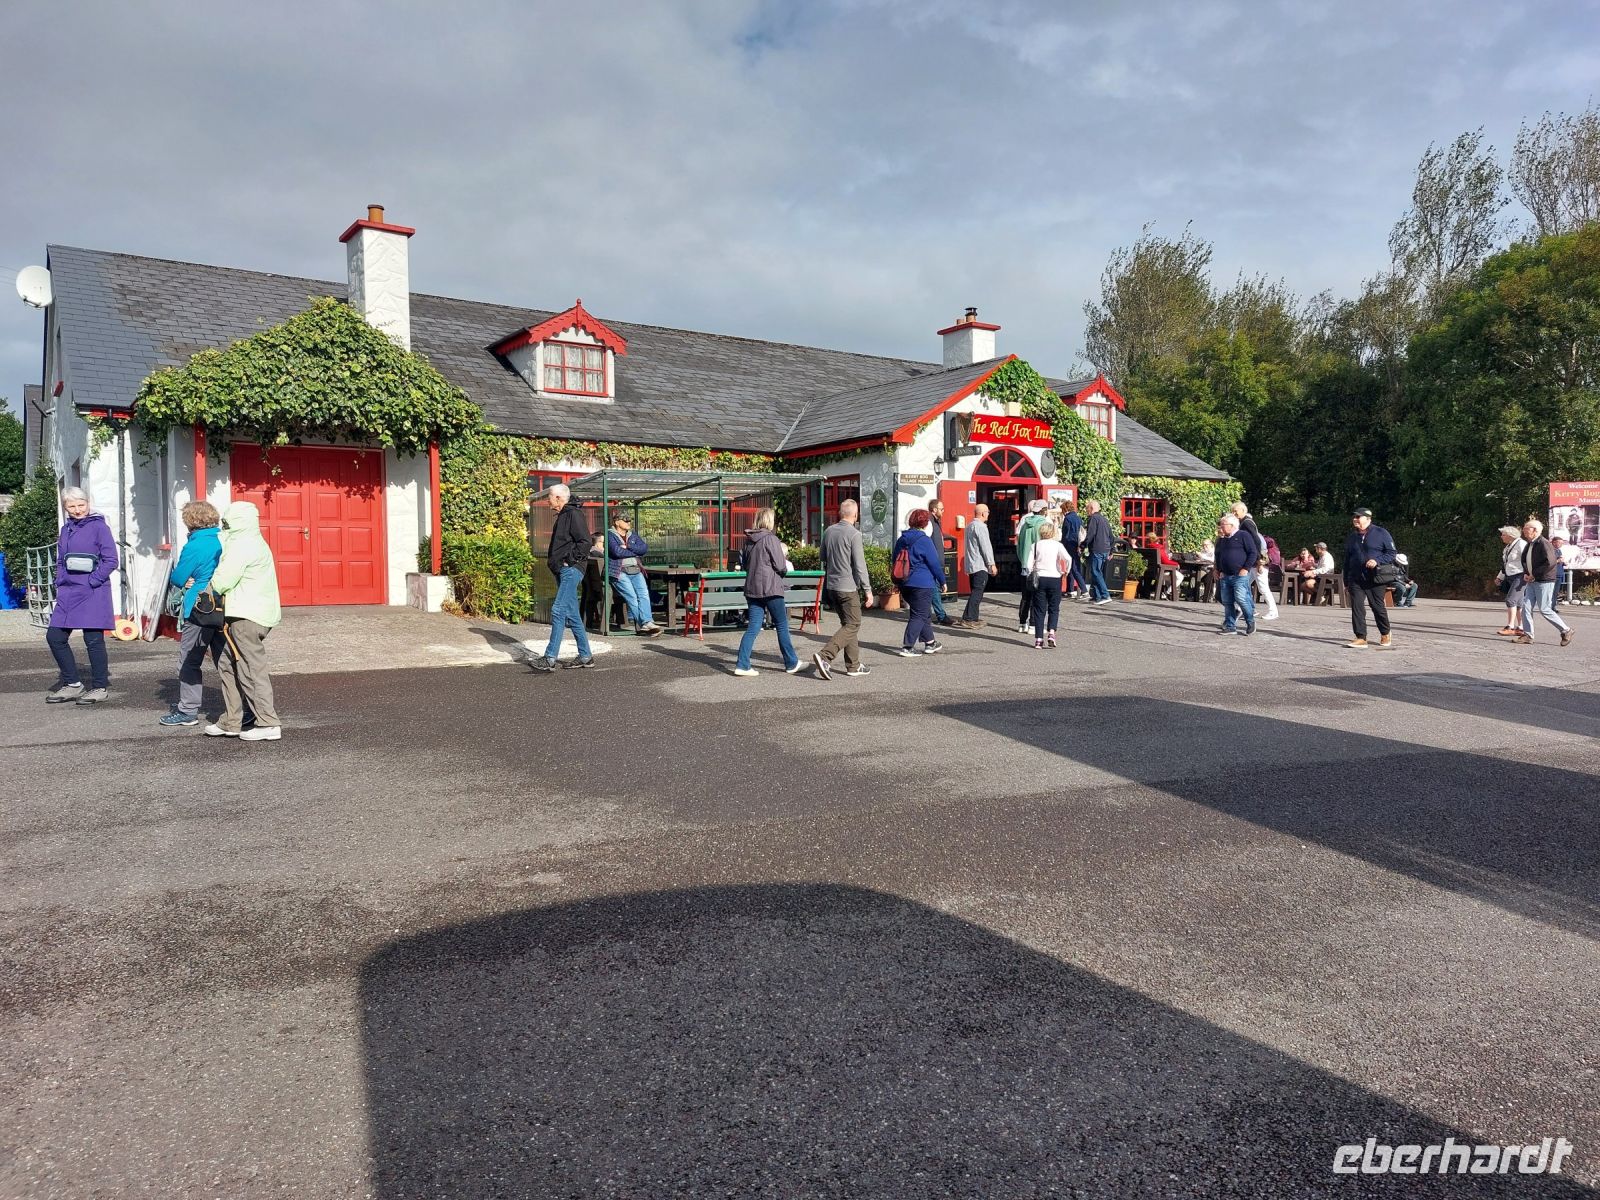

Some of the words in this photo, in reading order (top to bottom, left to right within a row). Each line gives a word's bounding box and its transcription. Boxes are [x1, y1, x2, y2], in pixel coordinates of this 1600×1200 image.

[973, 418, 987, 433] he
[989, 421, 1012, 438] Red
[1011, 424, 1032, 441] Fox
[1554, 490, 1580, 499] Kerry
[1583, 489, 1600, 498] Bog
